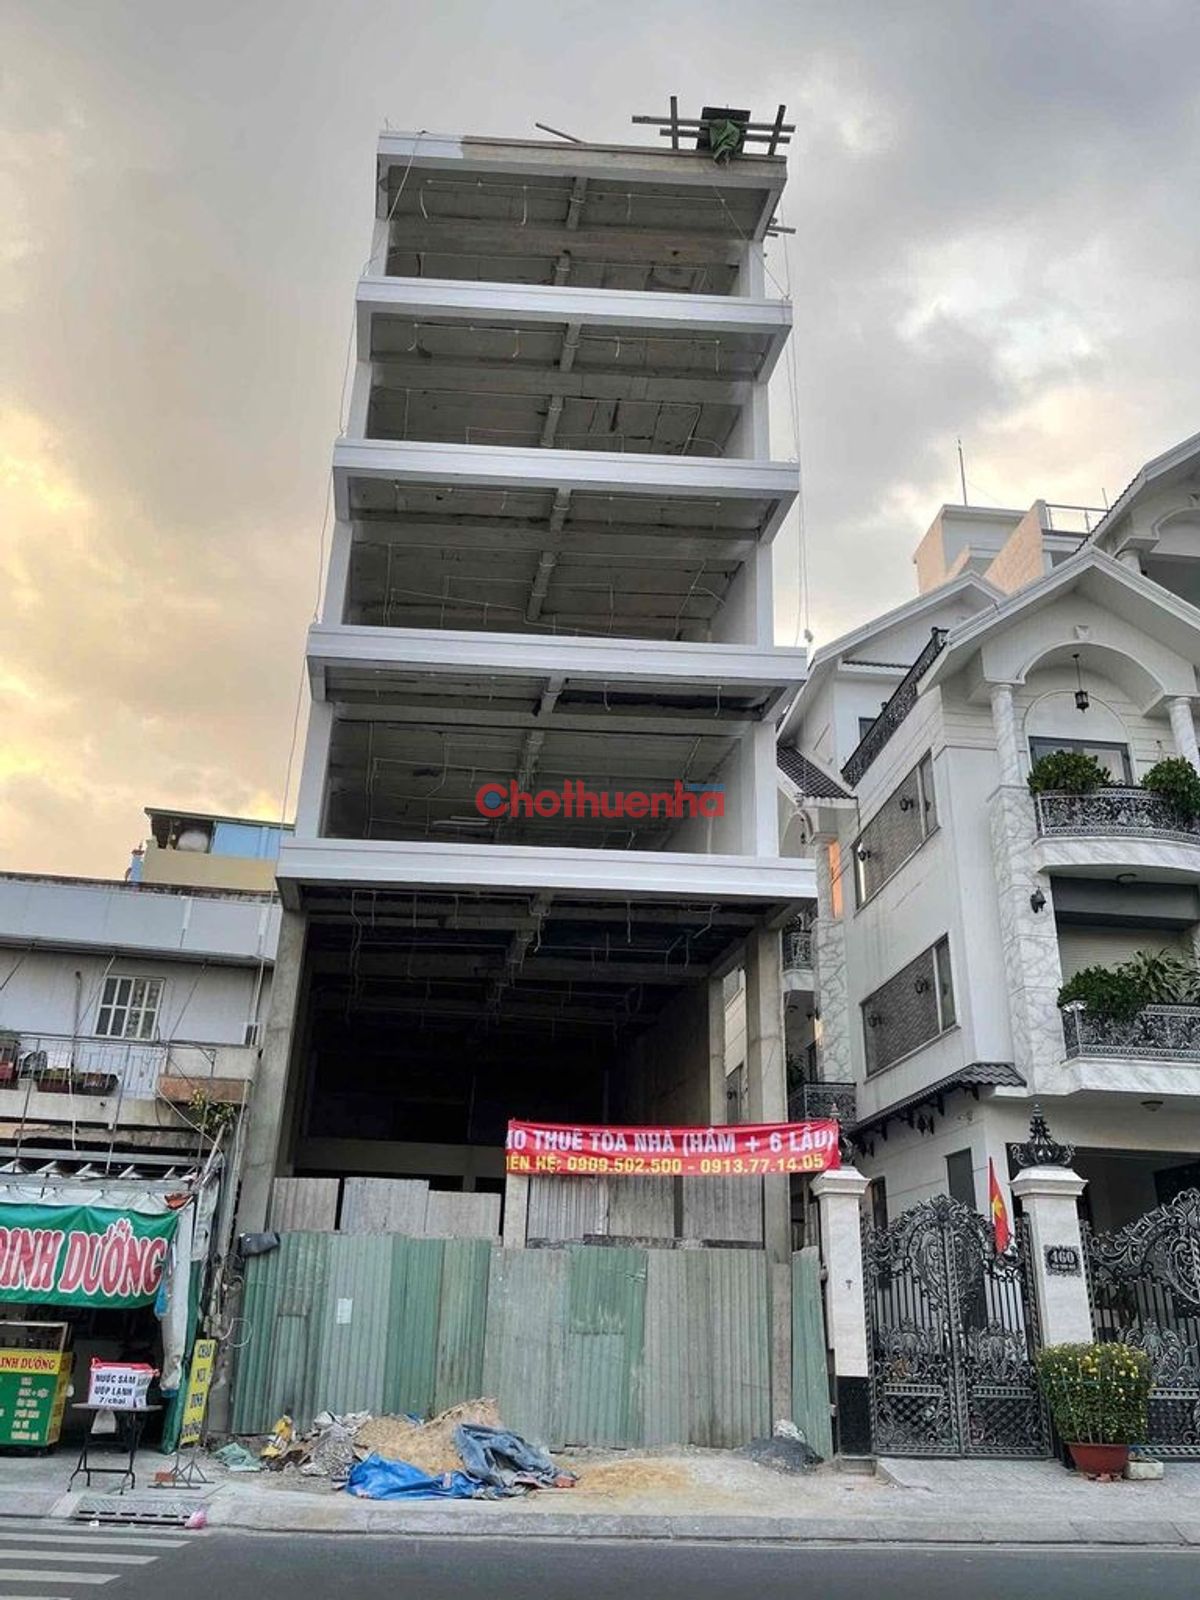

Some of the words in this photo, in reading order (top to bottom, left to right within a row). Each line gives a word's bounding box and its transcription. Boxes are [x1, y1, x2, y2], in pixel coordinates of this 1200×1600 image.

[533, 1127, 583, 1151] THUÊ
[589, 1129, 628, 1152] TÒA
[634, 1129, 675, 1152] NHÀ
[682, 1127, 736, 1156] (HẦM
[745, 1136, 760, 1152] +
[769, 1132, 783, 1152] 6
[567, 1156, 681, 1173] 0909.502.500
[701, 1154, 824, 1173] 0913.77.14.05
[58, 1218, 168, 1297] DƯỠNG
